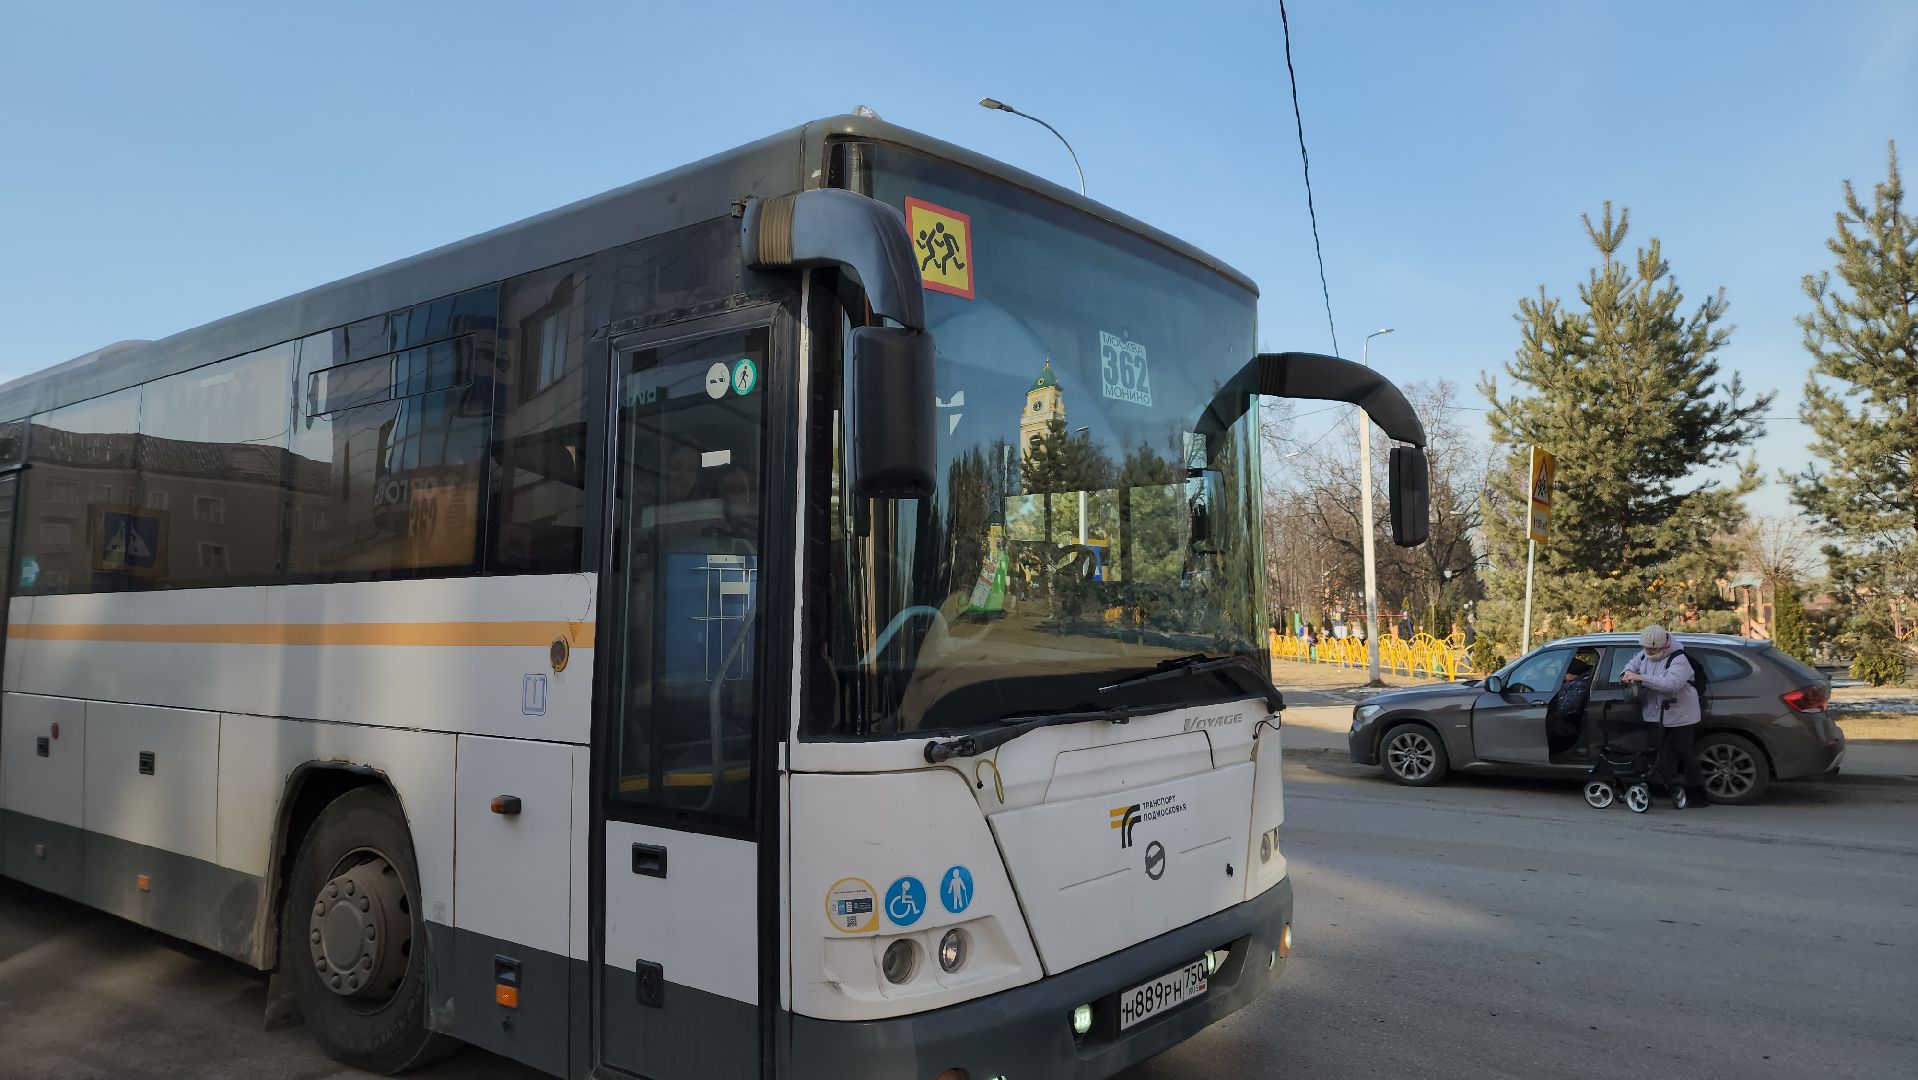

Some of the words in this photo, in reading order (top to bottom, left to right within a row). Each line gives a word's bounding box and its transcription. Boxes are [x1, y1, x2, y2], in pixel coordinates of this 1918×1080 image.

[1103, 333, 1144, 355] МОСКВА
[1103, 345, 1148, 394] 362
[1106, 385, 1150, 405] МОНИНО
[1142, 795, 1176, 810] ТРАНСПОРТ
[1143, 803, 1187, 821] ПОДМОСКОВЬЯ
[1184, 962, 1204, 988] 750
